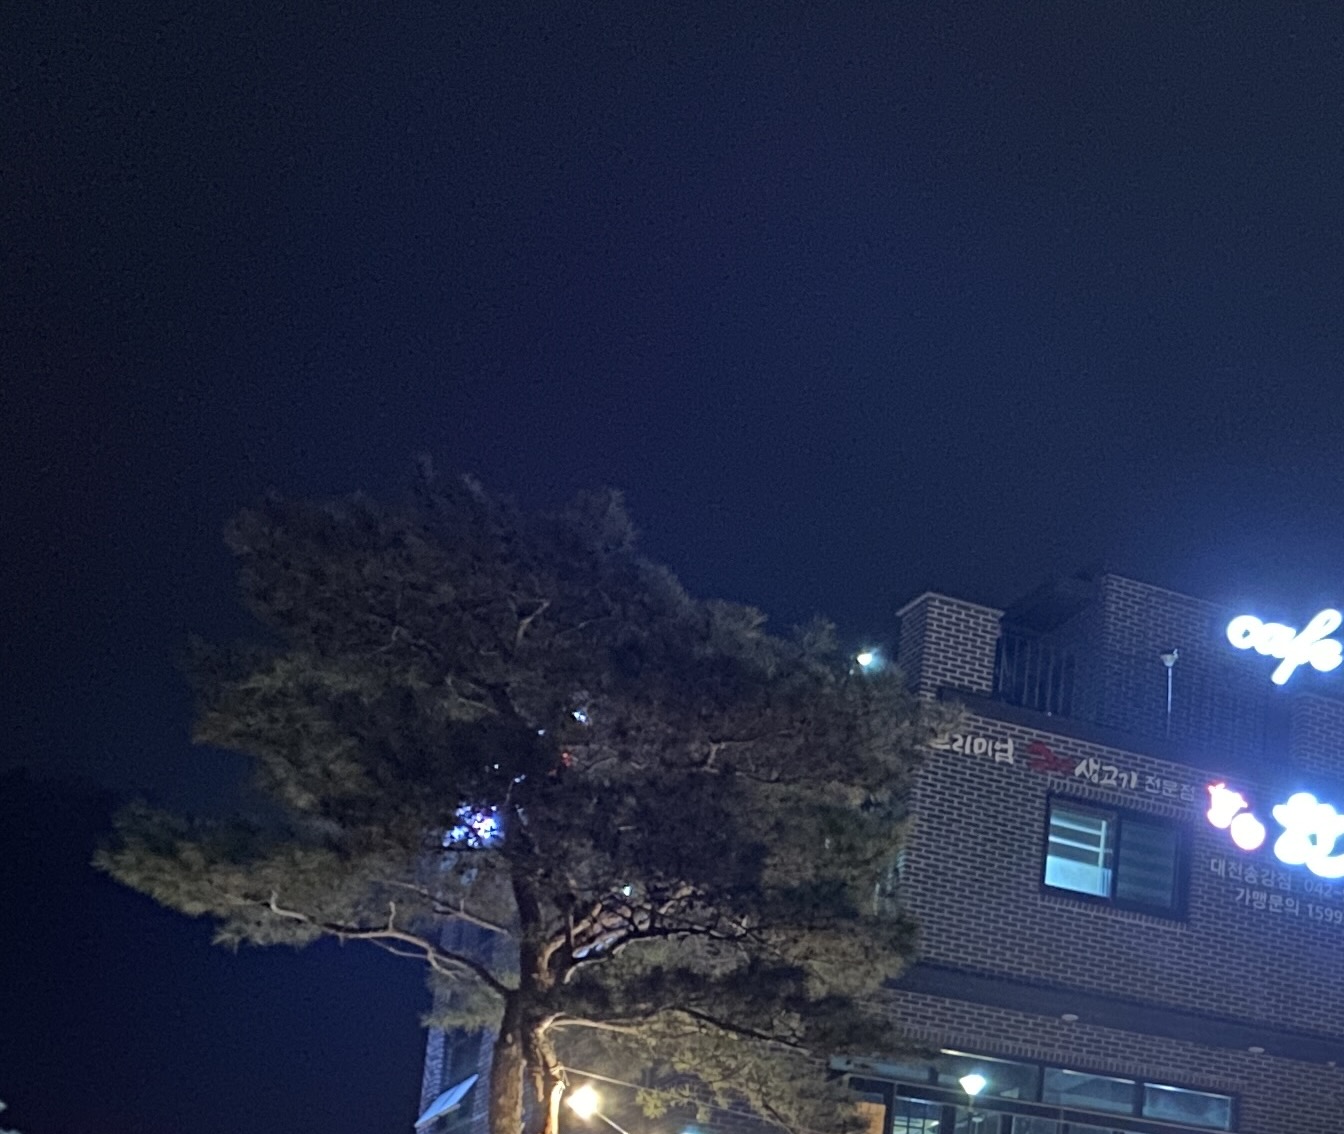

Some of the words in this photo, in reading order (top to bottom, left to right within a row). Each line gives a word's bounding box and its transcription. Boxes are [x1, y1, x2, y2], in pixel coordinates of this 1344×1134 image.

[1074, 757, 1138, 790] 생고기
[1144, 776, 1196, 802] 전문점
[1210, 858, 1293, 891] 대전송강점
[1234, 887, 1300, 917] 가맹문의
